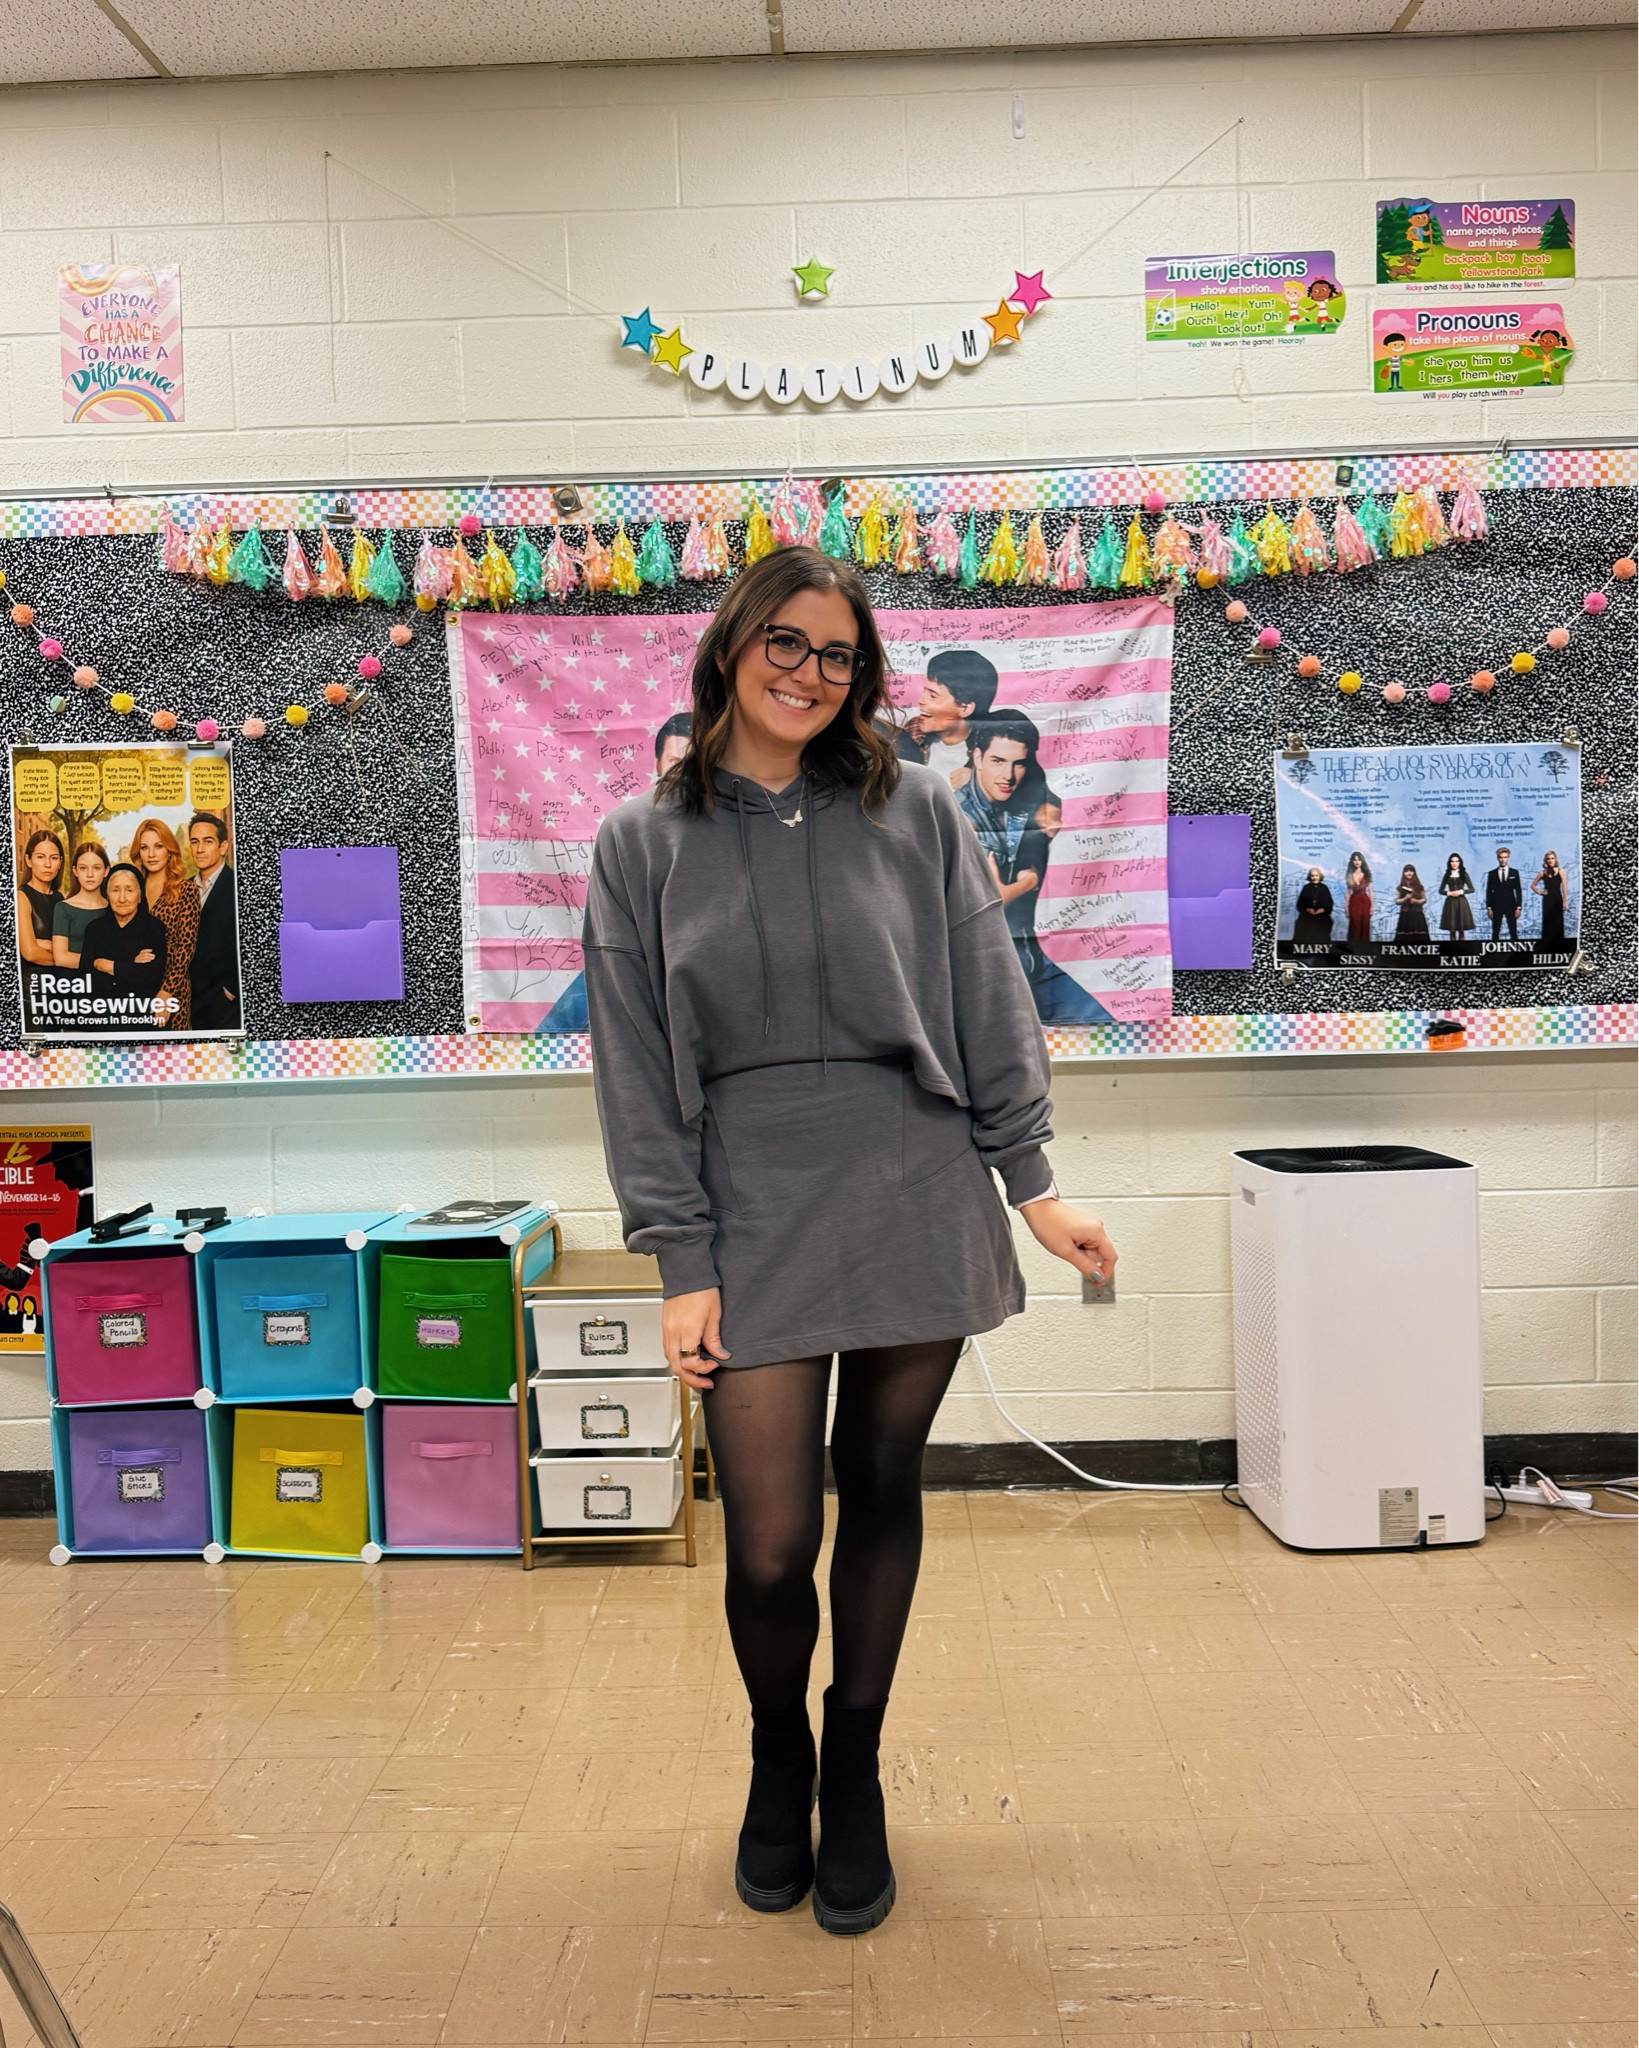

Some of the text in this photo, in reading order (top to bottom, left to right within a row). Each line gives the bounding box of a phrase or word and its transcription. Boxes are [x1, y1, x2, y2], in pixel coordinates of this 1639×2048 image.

[1463, 205, 1529, 224] Nouns
[1446, 225, 1544, 237] name people, places,
[1468, 238, 1520, 249] and things.
[1444, 252, 1551, 265] backpack boy boots
[1168, 256, 1307, 283] Interjections
[1460, 266, 1544, 278] Yellowstone Park
[1201, 284, 1272, 296] show emotion.
[1450, 283, 1462, 292] dog
[1511, 280, 1522, 288] the
[1524, 280, 1545, 288] forest.
[82, 292, 162, 317] EVERYONE
[1190, 302, 1220, 311] Hello!
[1248, 300, 1275, 310] Yum!
[106, 308, 140, 320] HAS A
[1224, 310, 1248, 320] Hey!
[1263, 312, 1282, 322] Oh!
[1186, 316, 1217, 326] Ouch!
[1418, 313, 1520, 332] Pronouns
[84, 320, 162, 344] CHANCE
[1218, 323, 1265, 334] Look out!
[1252, 339, 1275, 347] game!
[1278, 337, 1305, 346] Hooray!
[1409, 332, 1529, 346] take the place of nouns.
[78, 344, 168, 361] TO MAKE A
[701, 329, 978, 397] PLATINUM
[1425, 357, 1444, 366] she
[1447, 360, 1467, 370] you
[1472, 356, 1492, 366] him
[65, 361, 175, 394] Difference
[1419, 371, 1518, 384] I hers them they
[1422, 392, 1436, 400] Will
[1452, 391, 1468, 400] play
[1469, 389, 1490, 398] catch
[1492, 388, 1508, 396] with
[1509, 388, 1524, 396] me?
[644, 626, 688, 650] Sophia
[480, 629, 546, 670] PEYTON
[1057, 702, 1154, 738] Happy Birthday
[1052, 737, 1080, 753] Mrs
[1320, 756, 1348, 772] THE
[1495, 752, 1516, 766] OF
[1522, 752, 1531, 766] A
[1325, 769, 1362, 783] TREE
[1366, 766, 1426, 782] GROWS
[1446, 764, 1529, 780] BROOKLYN
[488, 788, 533, 828] Happy
[1071, 867, 1108, 891] Happy
[1292, 944, 1332, 954] MARY
[1381, 945, 1440, 956] FRANCIE
[1481, 942, 1536, 956] JOHNNY
[1340, 954, 1376, 965] SISSY
[1440, 956, 1481, 966] KATIE
[1533, 954, 1572, 964] HILDY
[30, 973, 38, 994] The
[40, 973, 92, 994] Real
[30, 992, 180, 1014] Housewives
[32, 1015, 165, 1026] Of A Tree Grows In Brooklyn
[60, 1130, 84, 1138] PRESENTS
[106, 1320, 134, 1328] Colored
[269, 1324, 303, 1335] Crayons
[110, 1328, 139, 1337] Pencils
[421, 1328, 456, 1336] Markers
[588, 1333, 615, 1341] Rulers
[128, 1482, 152, 1490] Sticks
[282, 1479, 312, 1488] Scissors
